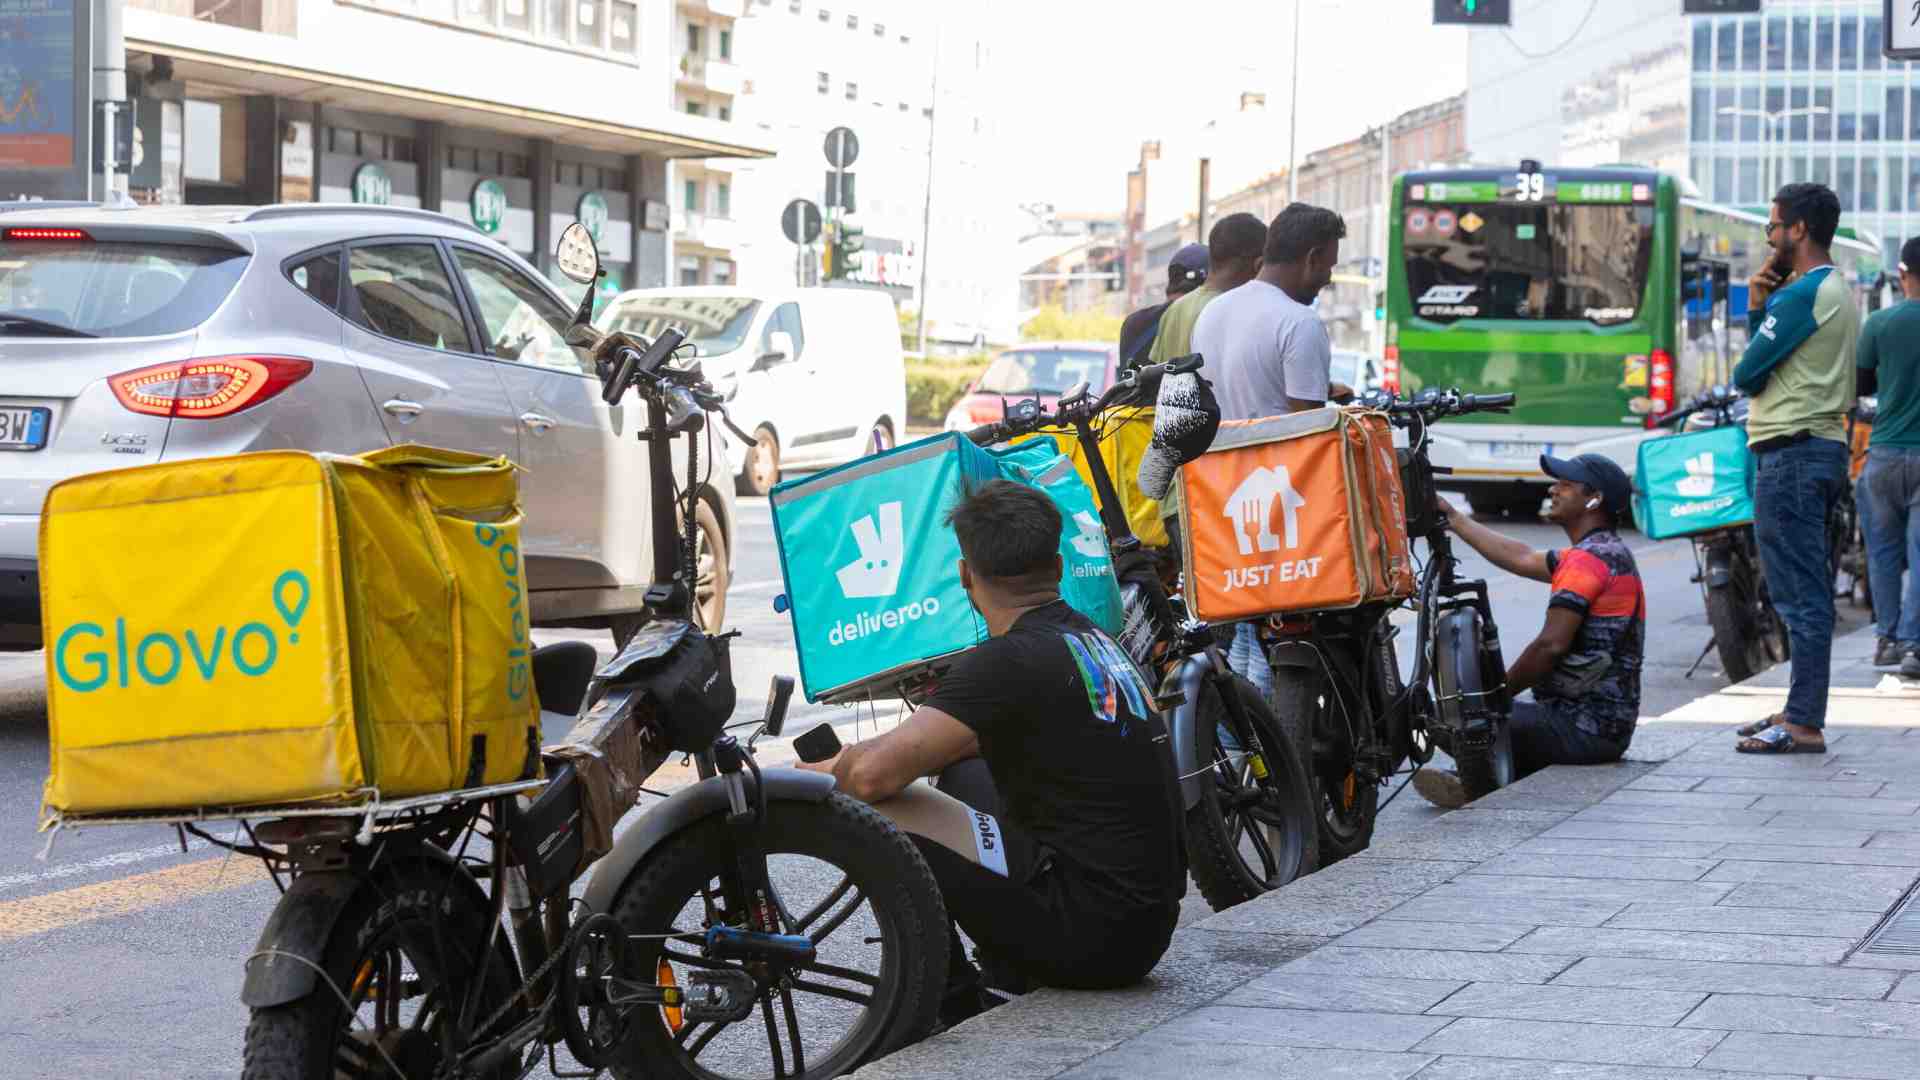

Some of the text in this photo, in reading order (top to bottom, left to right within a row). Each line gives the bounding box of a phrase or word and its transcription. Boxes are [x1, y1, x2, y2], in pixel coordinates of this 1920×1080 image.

[1515, 173, 1543, 201] 39
[1669, 496, 1733, 518] deliveroo
[1223, 557, 1322, 592] JUST EAT
[828, 597, 941, 646] deliveroo
